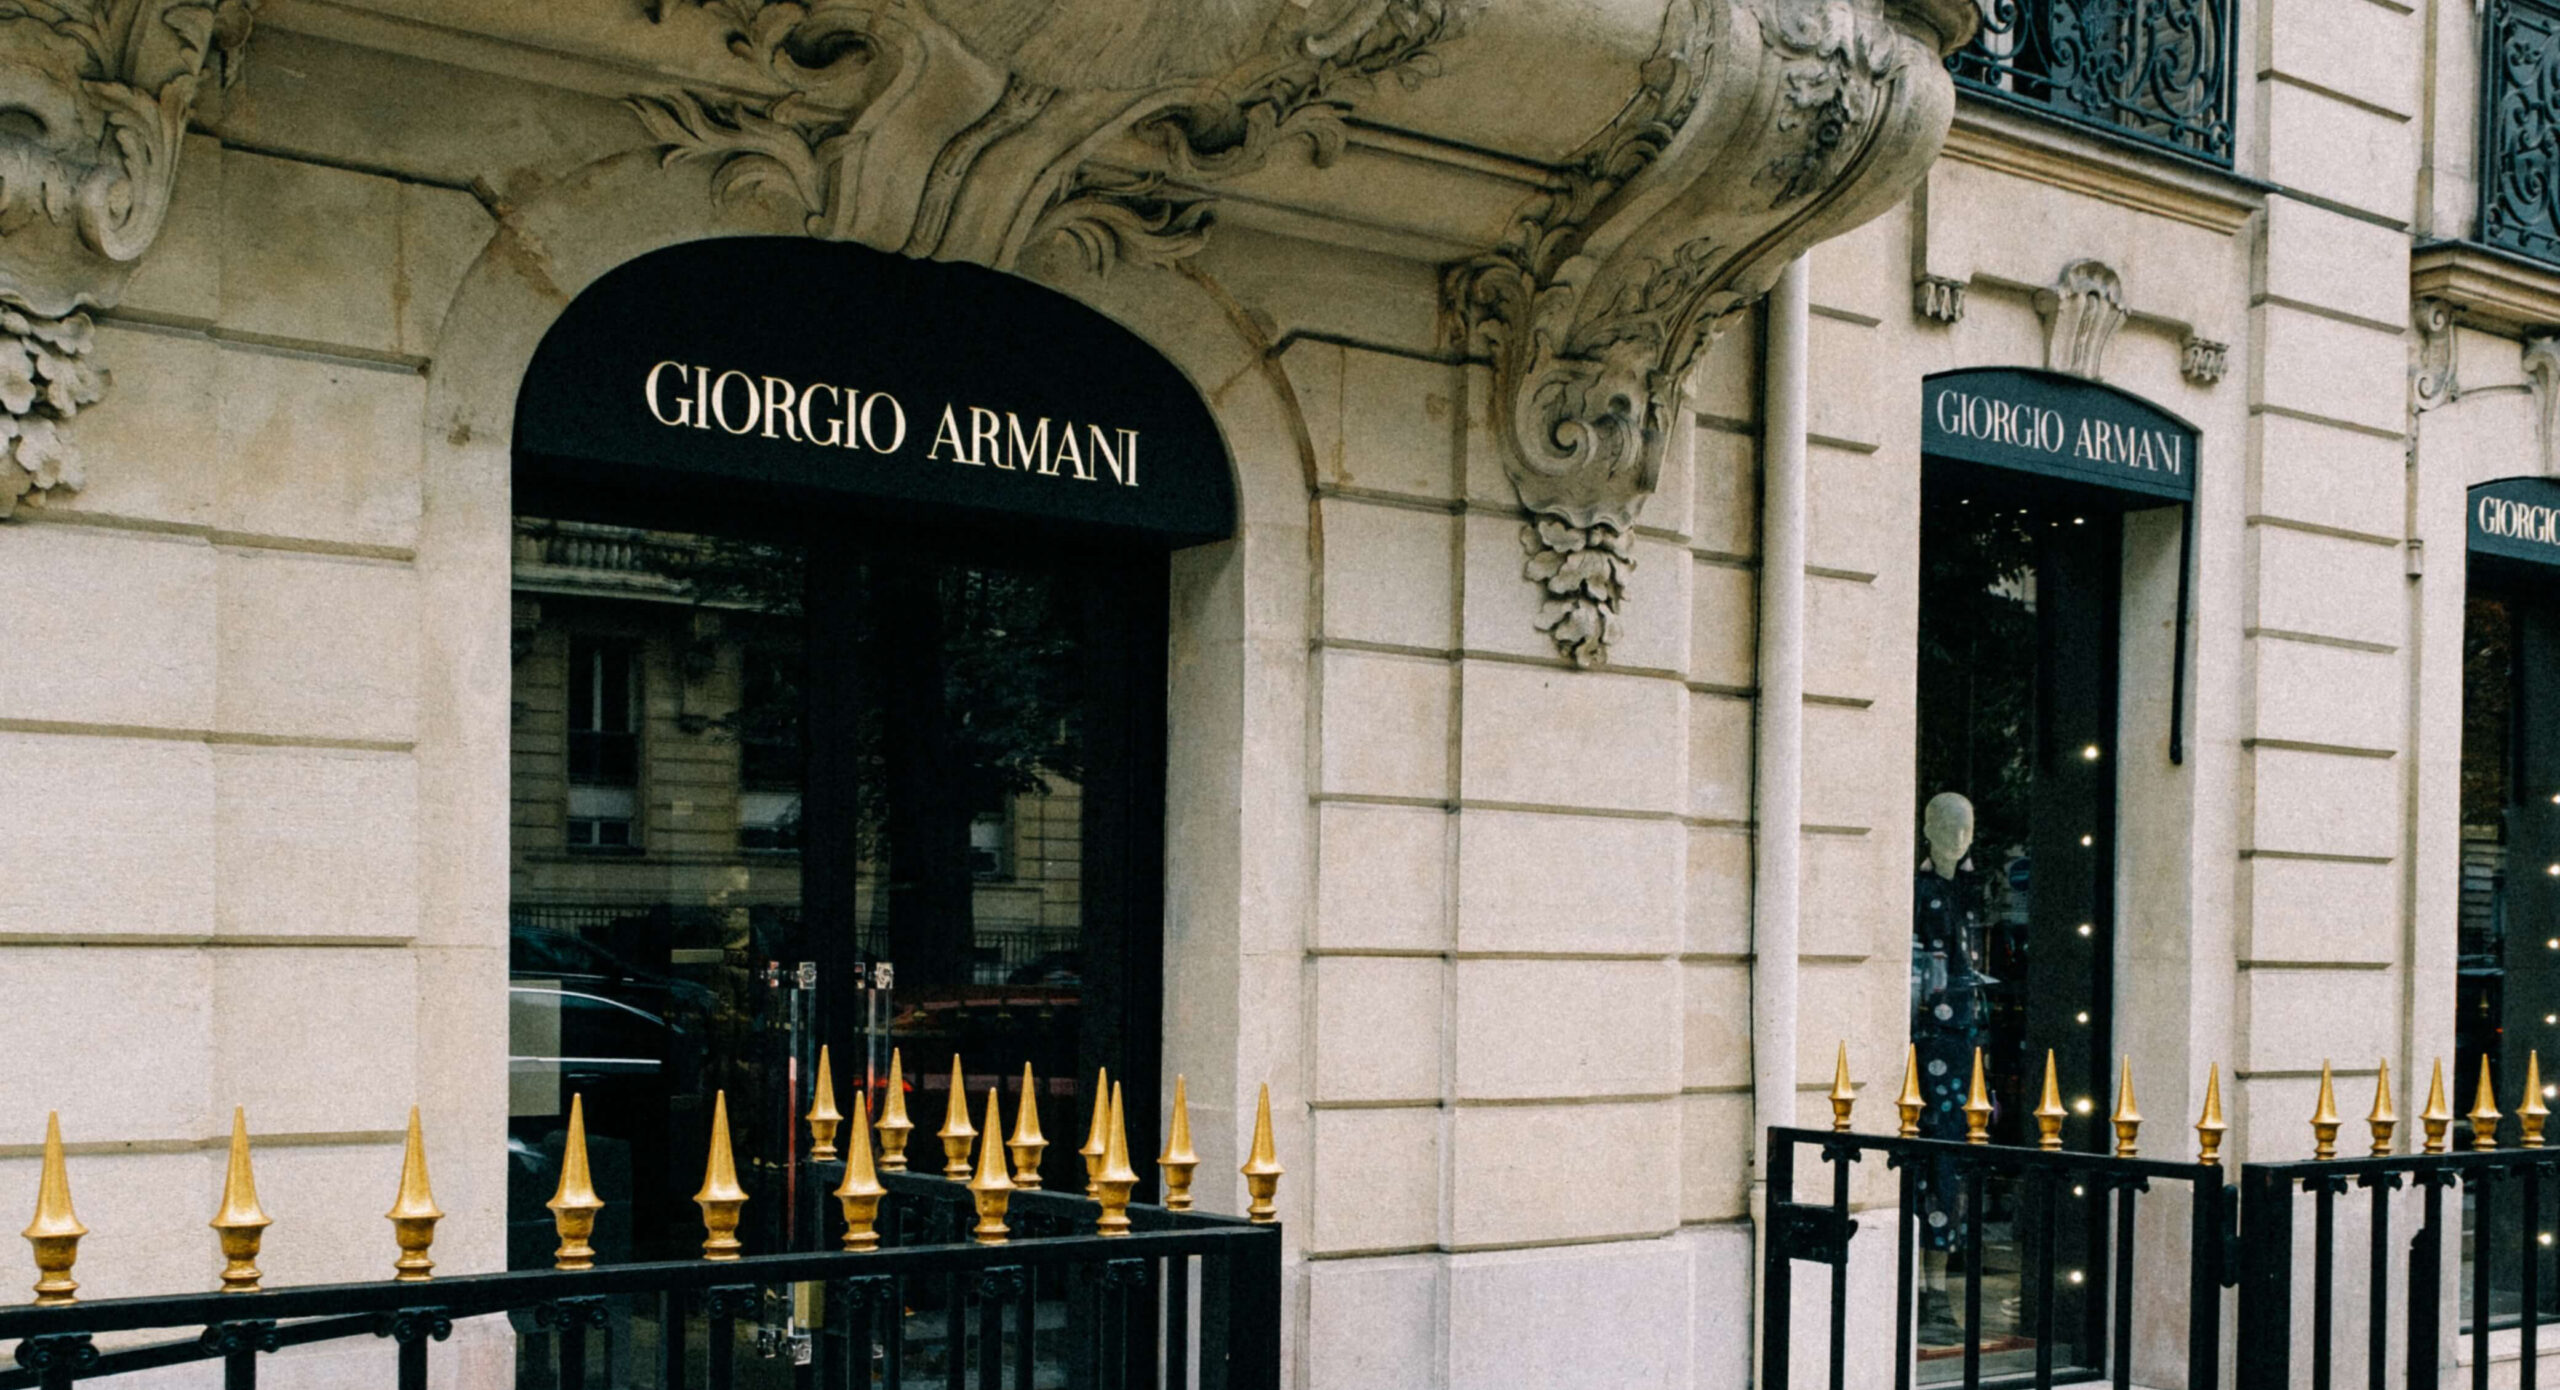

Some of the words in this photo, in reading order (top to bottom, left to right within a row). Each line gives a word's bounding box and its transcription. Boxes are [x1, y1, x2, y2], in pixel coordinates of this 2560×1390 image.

[645, 360, 906, 454] GIORGIO
[927, 402, 1139, 486] ARMANI
[1937, 390, 2065, 453] GIORGIO
[2074, 417, 2182, 475] ARMANI
